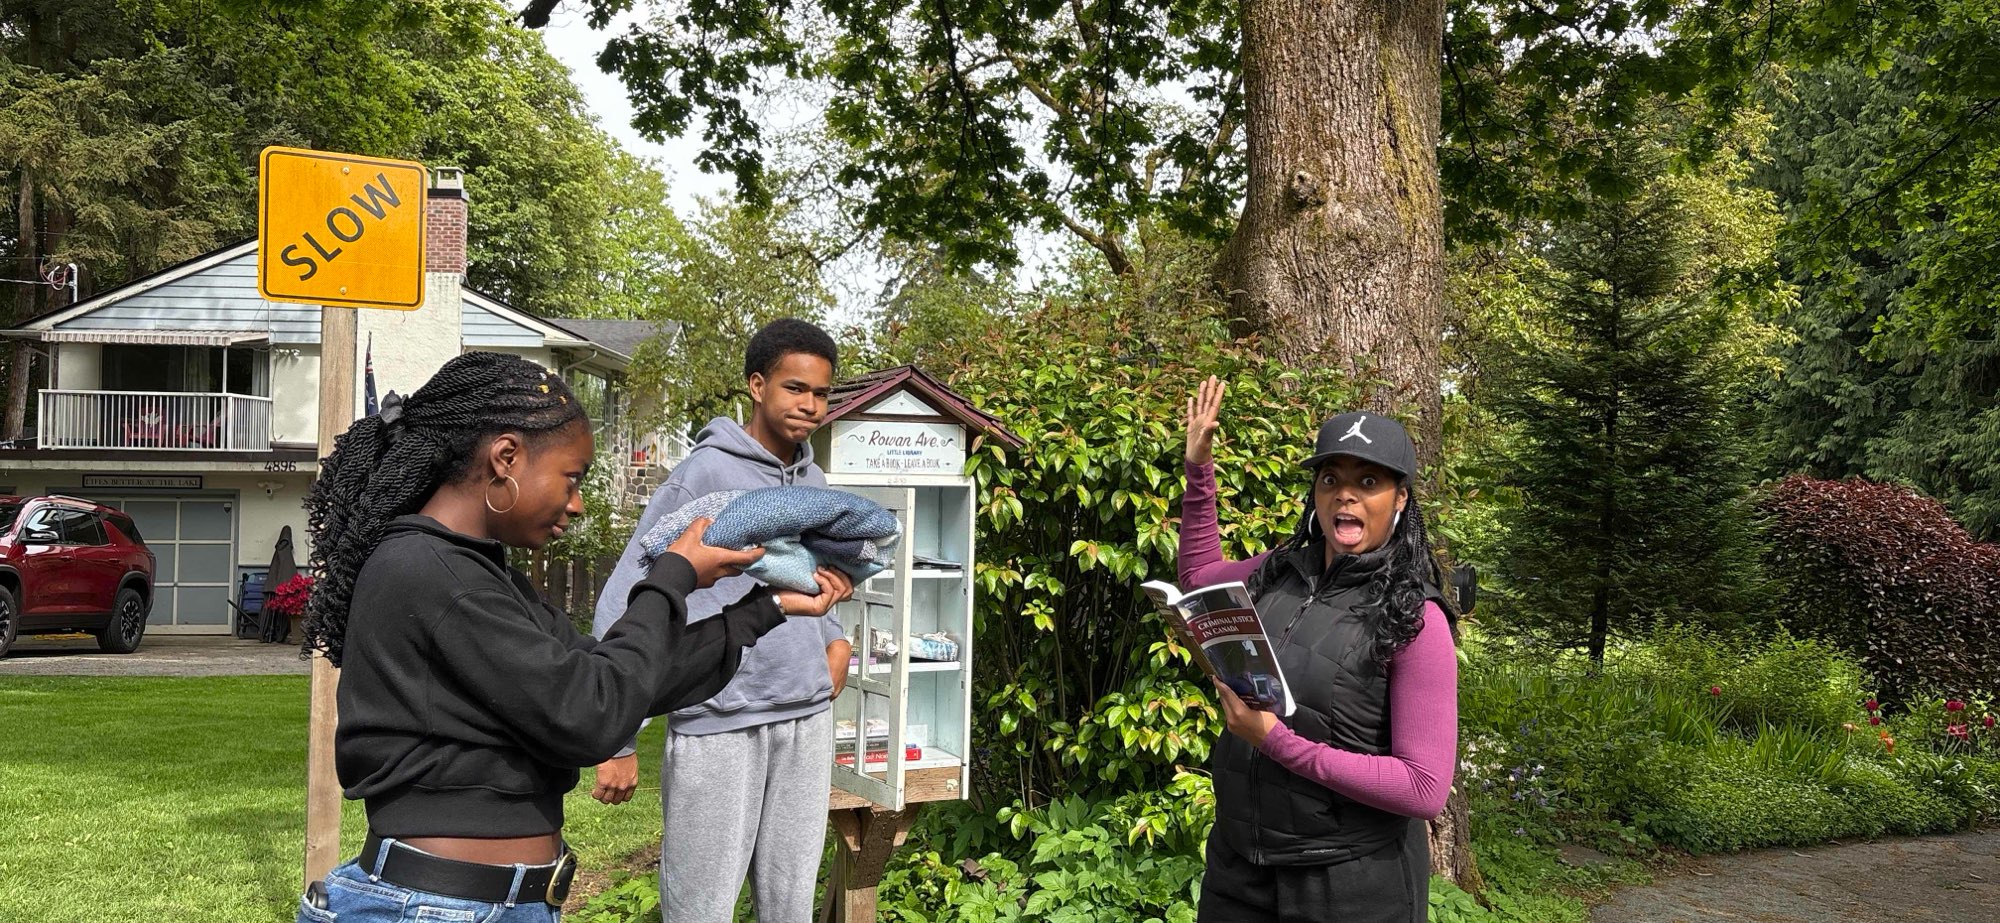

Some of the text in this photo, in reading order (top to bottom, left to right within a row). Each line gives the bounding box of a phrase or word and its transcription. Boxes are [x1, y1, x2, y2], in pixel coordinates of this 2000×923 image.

[280, 172, 402, 282] SLOW
[868, 430, 939, 448] Rowan Ave.
[264, 460, 297, 473] 4896
[866, 458, 881, 469] TAKE
[886, 458, 900, 469] BOOK
[904, 458, 920, 469] LEAVE
[927, 458, 940, 469] BOOK
[1198, 616, 1232, 630] CRIMINAL
[1231, 615, 1255, 624] JUSTICE
[1202, 625, 1239, 638] IN CANADA
